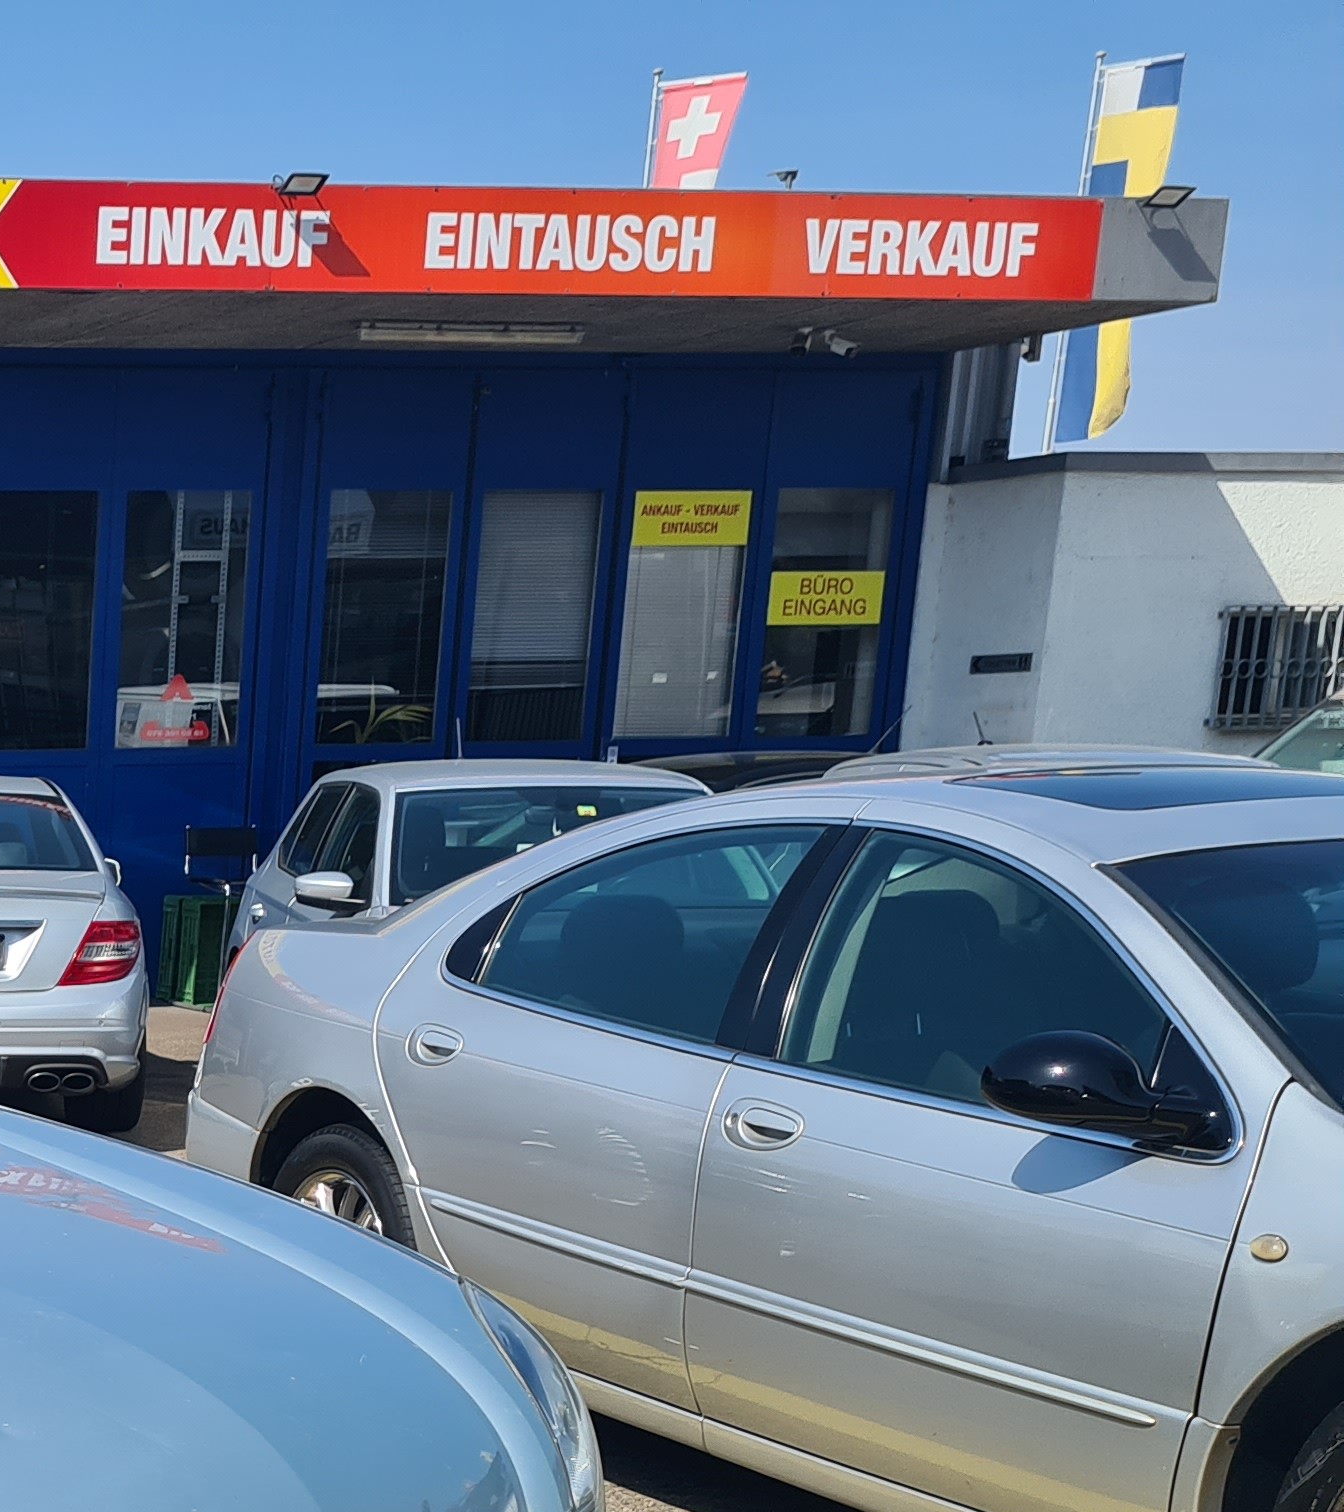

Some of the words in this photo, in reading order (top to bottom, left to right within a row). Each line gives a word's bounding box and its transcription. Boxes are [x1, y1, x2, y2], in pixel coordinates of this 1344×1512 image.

[96, 204, 330, 269] EINKAUF
[424, 210, 716, 273] EINTAUSCH
[805, 217, 1039, 279] VERKAUF
[640, 504, 684, 517] ANKAUF
[693, 503, 740, 517] VERKAUF
[660, 521, 718, 535] EINTAUSCH
[799, 575, 853, 596] BÜRO
[782, 599, 867, 617] EINGANG
